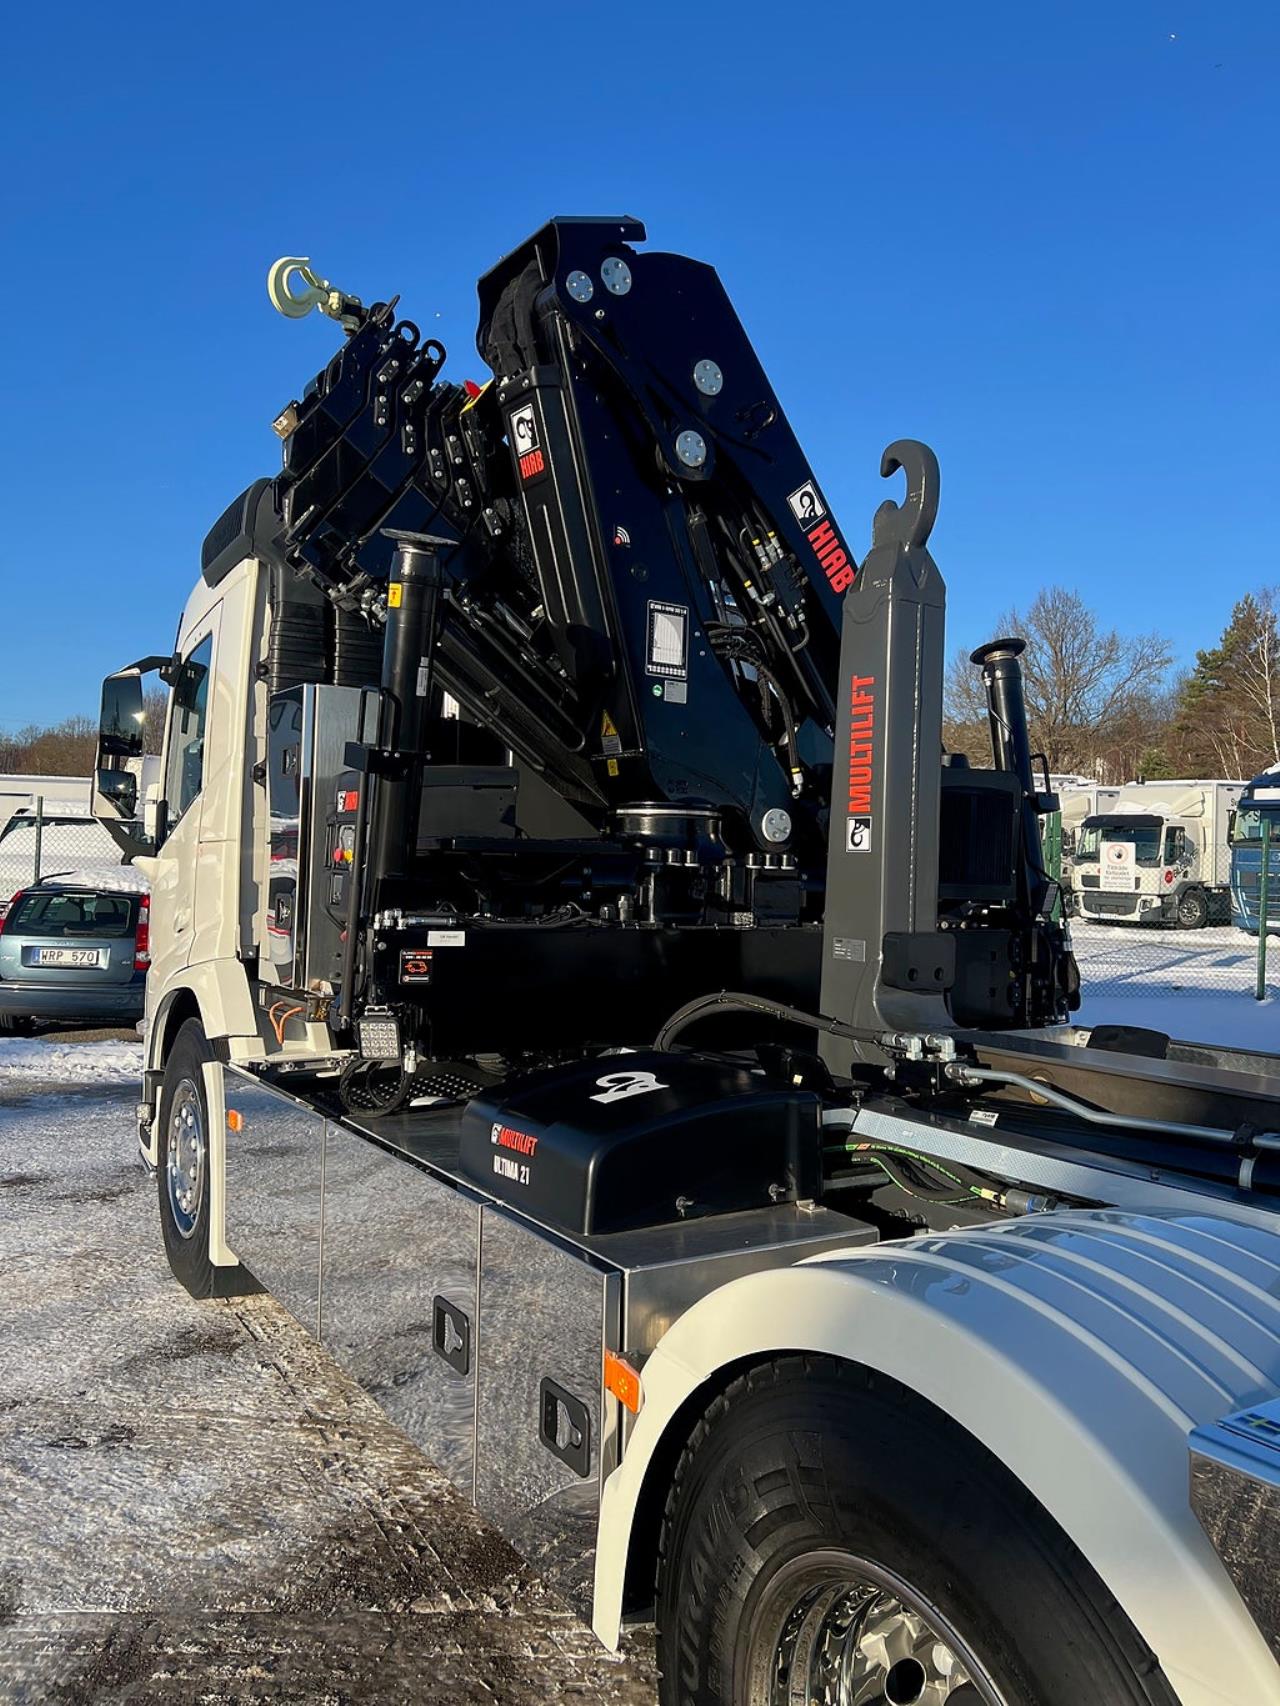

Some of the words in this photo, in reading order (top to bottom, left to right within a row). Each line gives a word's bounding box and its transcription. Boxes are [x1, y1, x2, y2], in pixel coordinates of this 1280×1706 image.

[519, 449, 545, 479] HIAB
[807, 520, 856, 593] HIAB
[848, 674, 876, 812] MULTILIFT
[41, 950, 64, 961] WRP
[71, 951, 95, 962] 570
[498, 1127, 538, 1157] MULTILIFT
[493, 1154, 519, 1181] ULTIMA
[519, 1165, 530, 1185] 21
